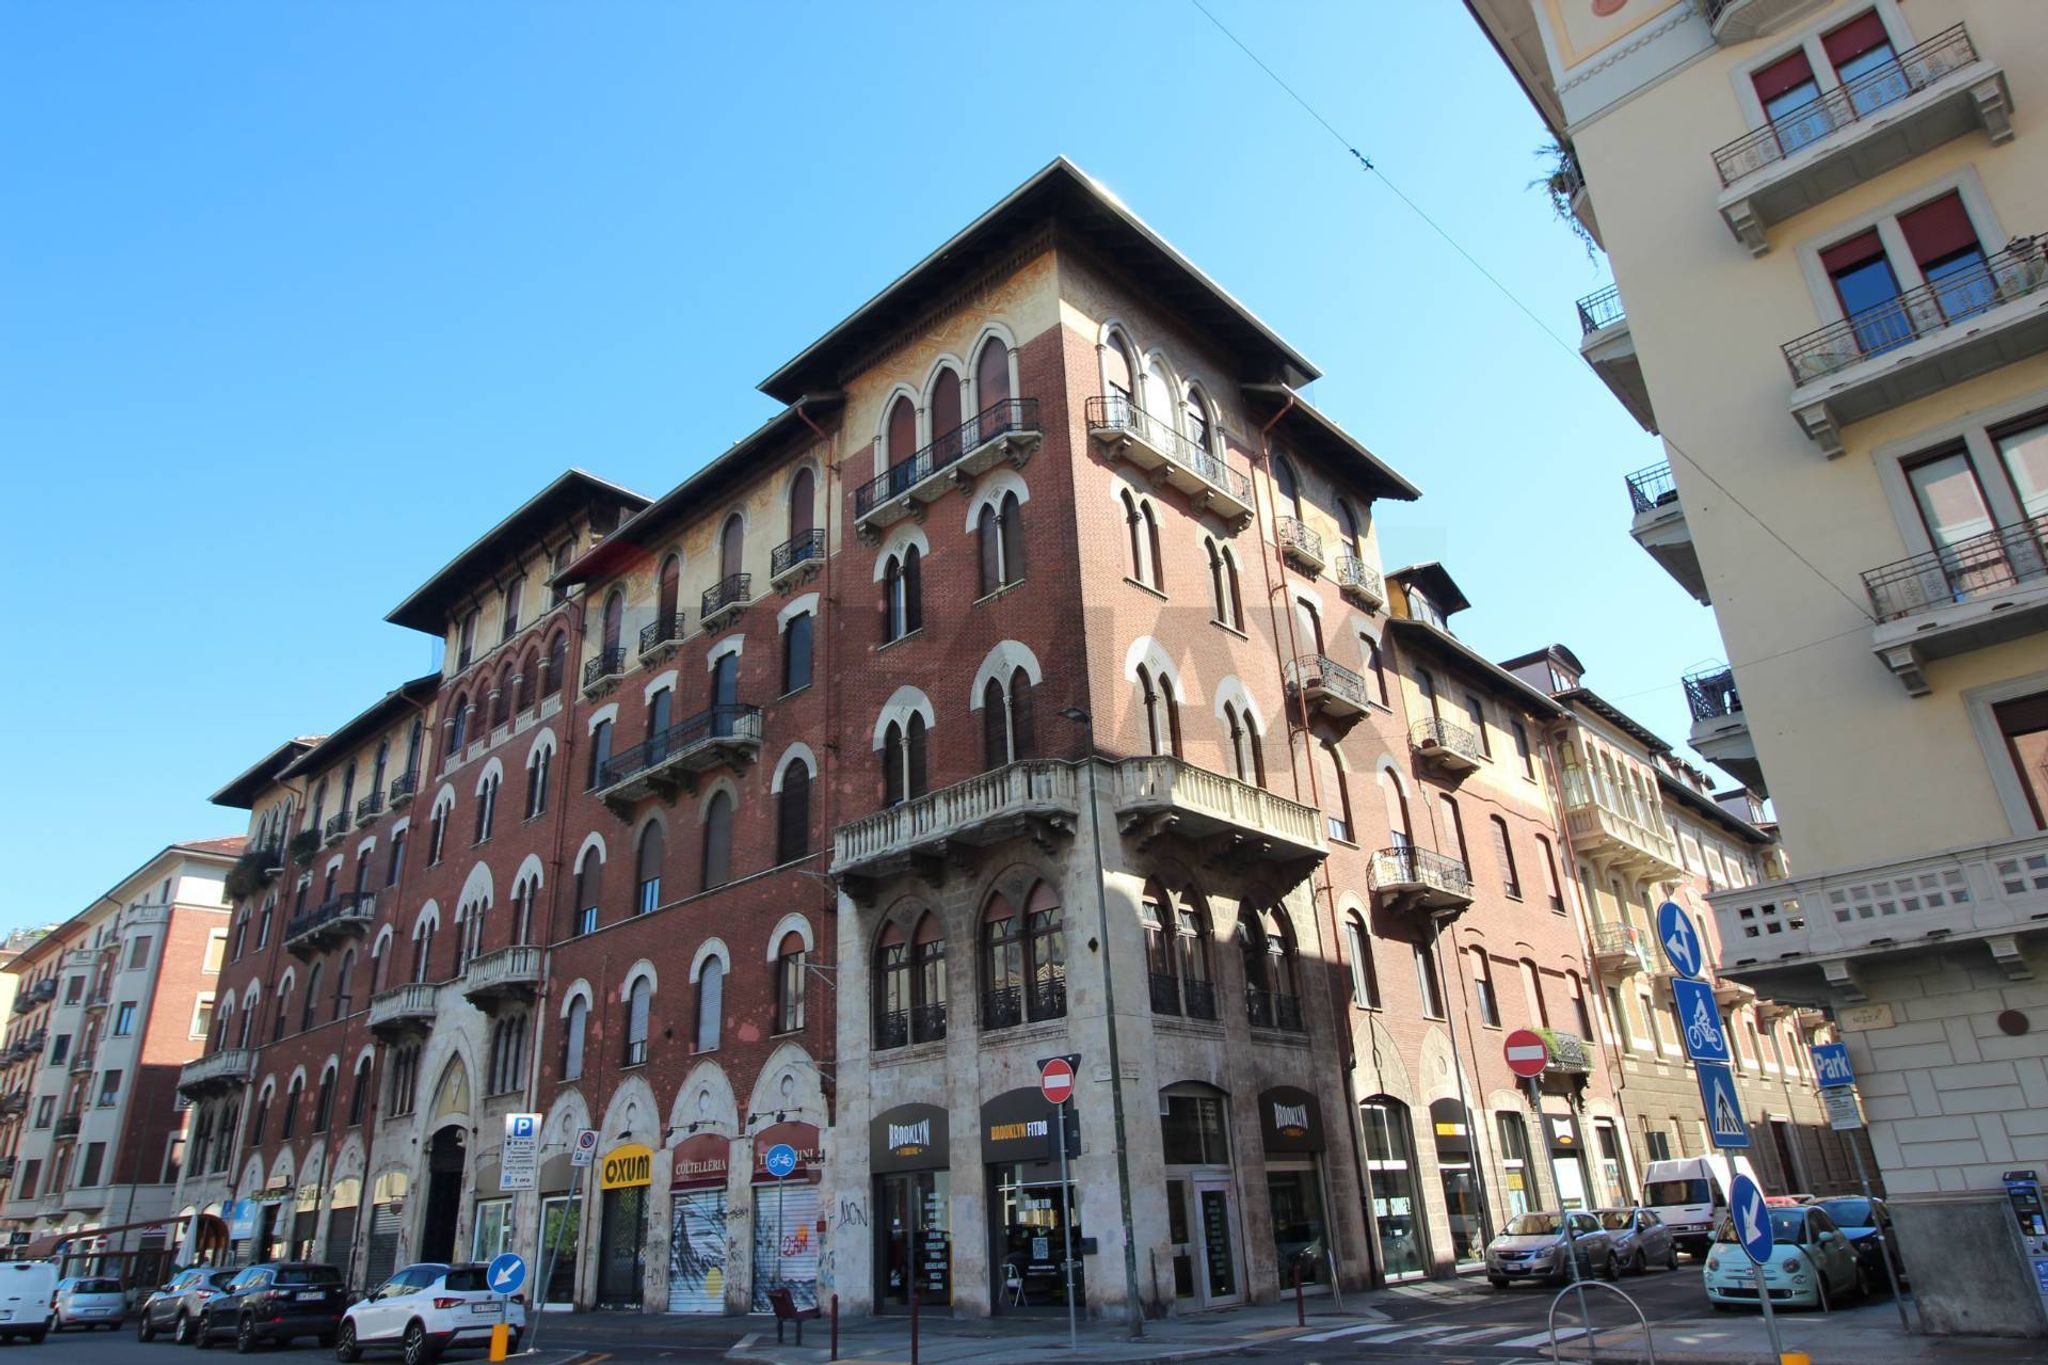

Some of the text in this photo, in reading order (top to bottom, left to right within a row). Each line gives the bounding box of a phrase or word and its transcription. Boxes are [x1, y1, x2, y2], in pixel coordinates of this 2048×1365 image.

[1813, 1050, 1851, 1080] Park
[1273, 1102, 1308, 1129] BROOKLYN
[888, 1118, 930, 1150] BROOKLYN
[991, 1123, 1026, 1141] BROOKLYN
[604, 1154, 650, 1184] OXUM
[675, 1159, 726, 1176] COLTELLERIA
